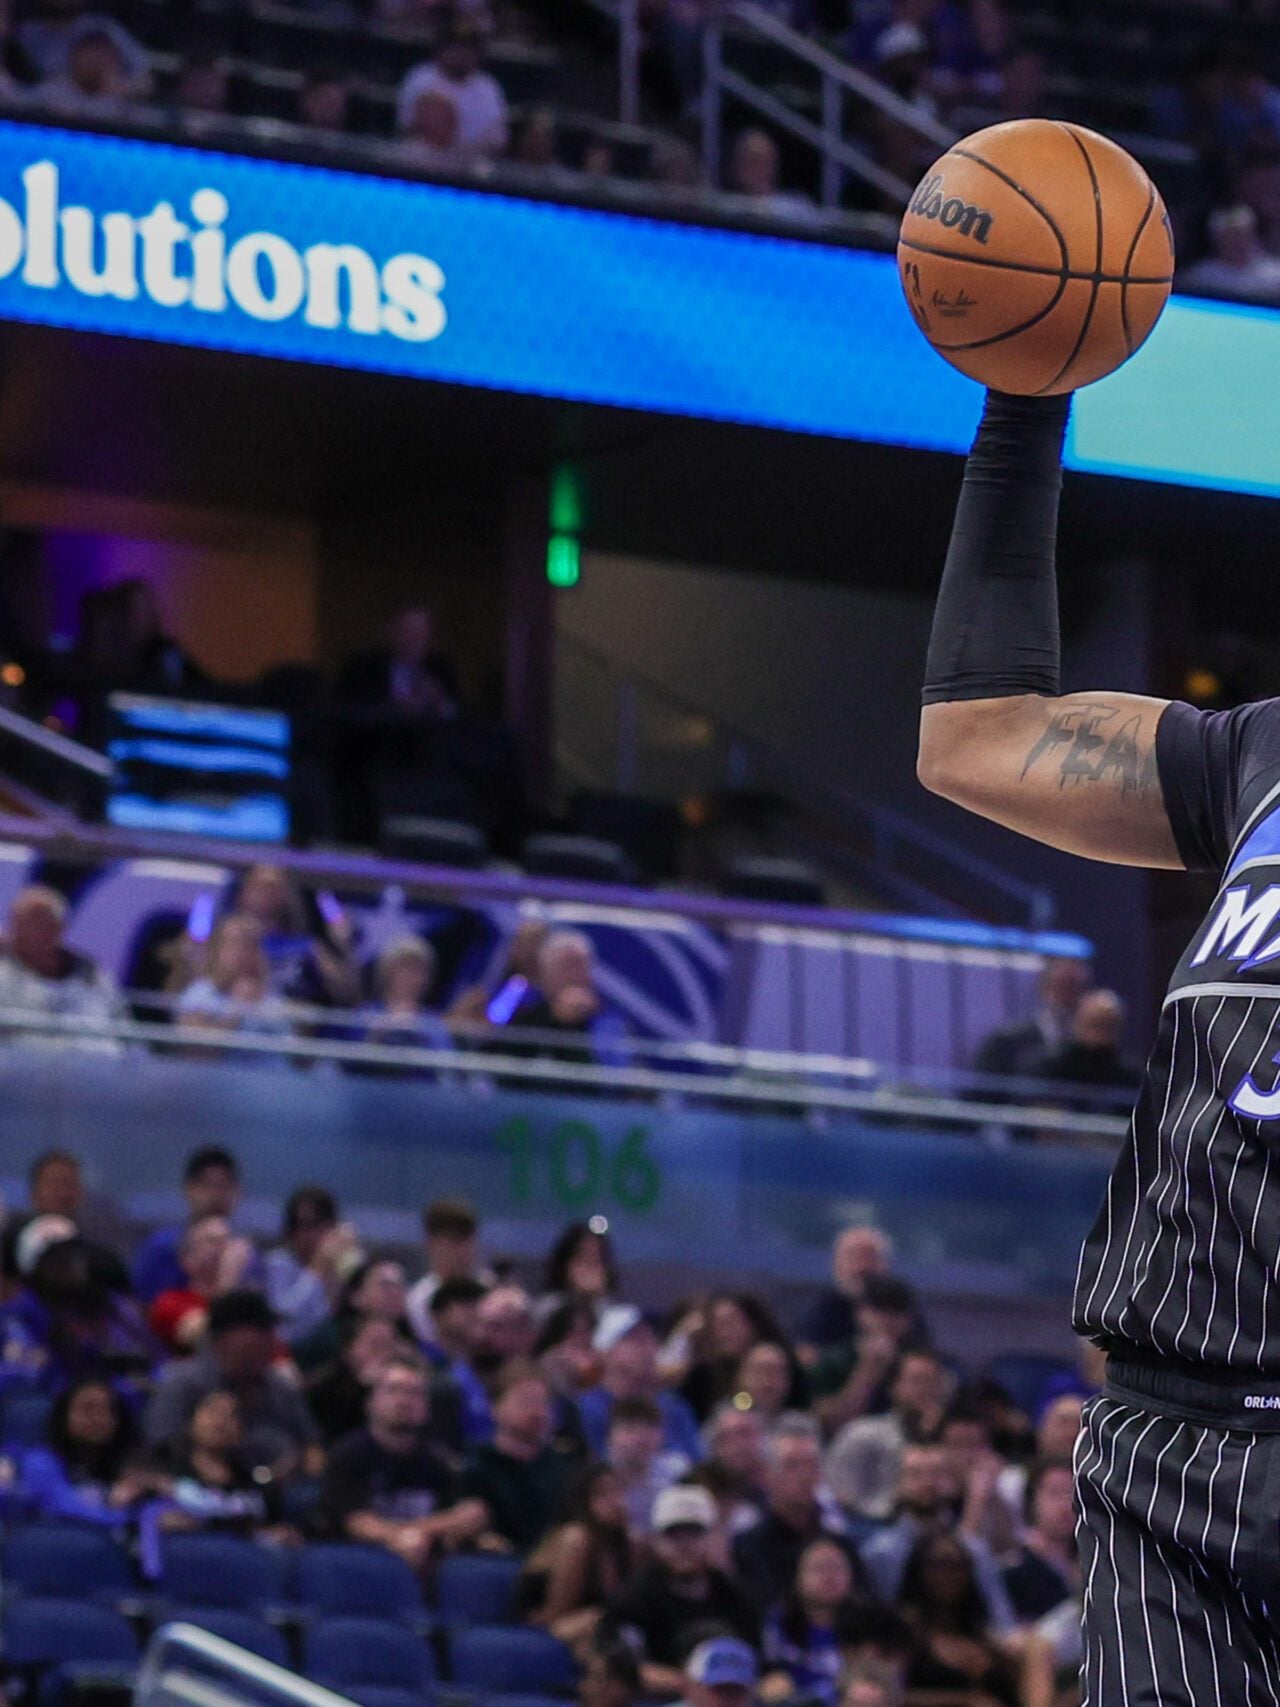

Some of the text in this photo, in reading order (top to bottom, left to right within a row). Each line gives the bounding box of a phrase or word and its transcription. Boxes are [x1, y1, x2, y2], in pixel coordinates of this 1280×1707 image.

[0, 161, 447, 342] lutions
[909, 173, 994, 245] ilson
[496, 1114, 662, 1216] 106
